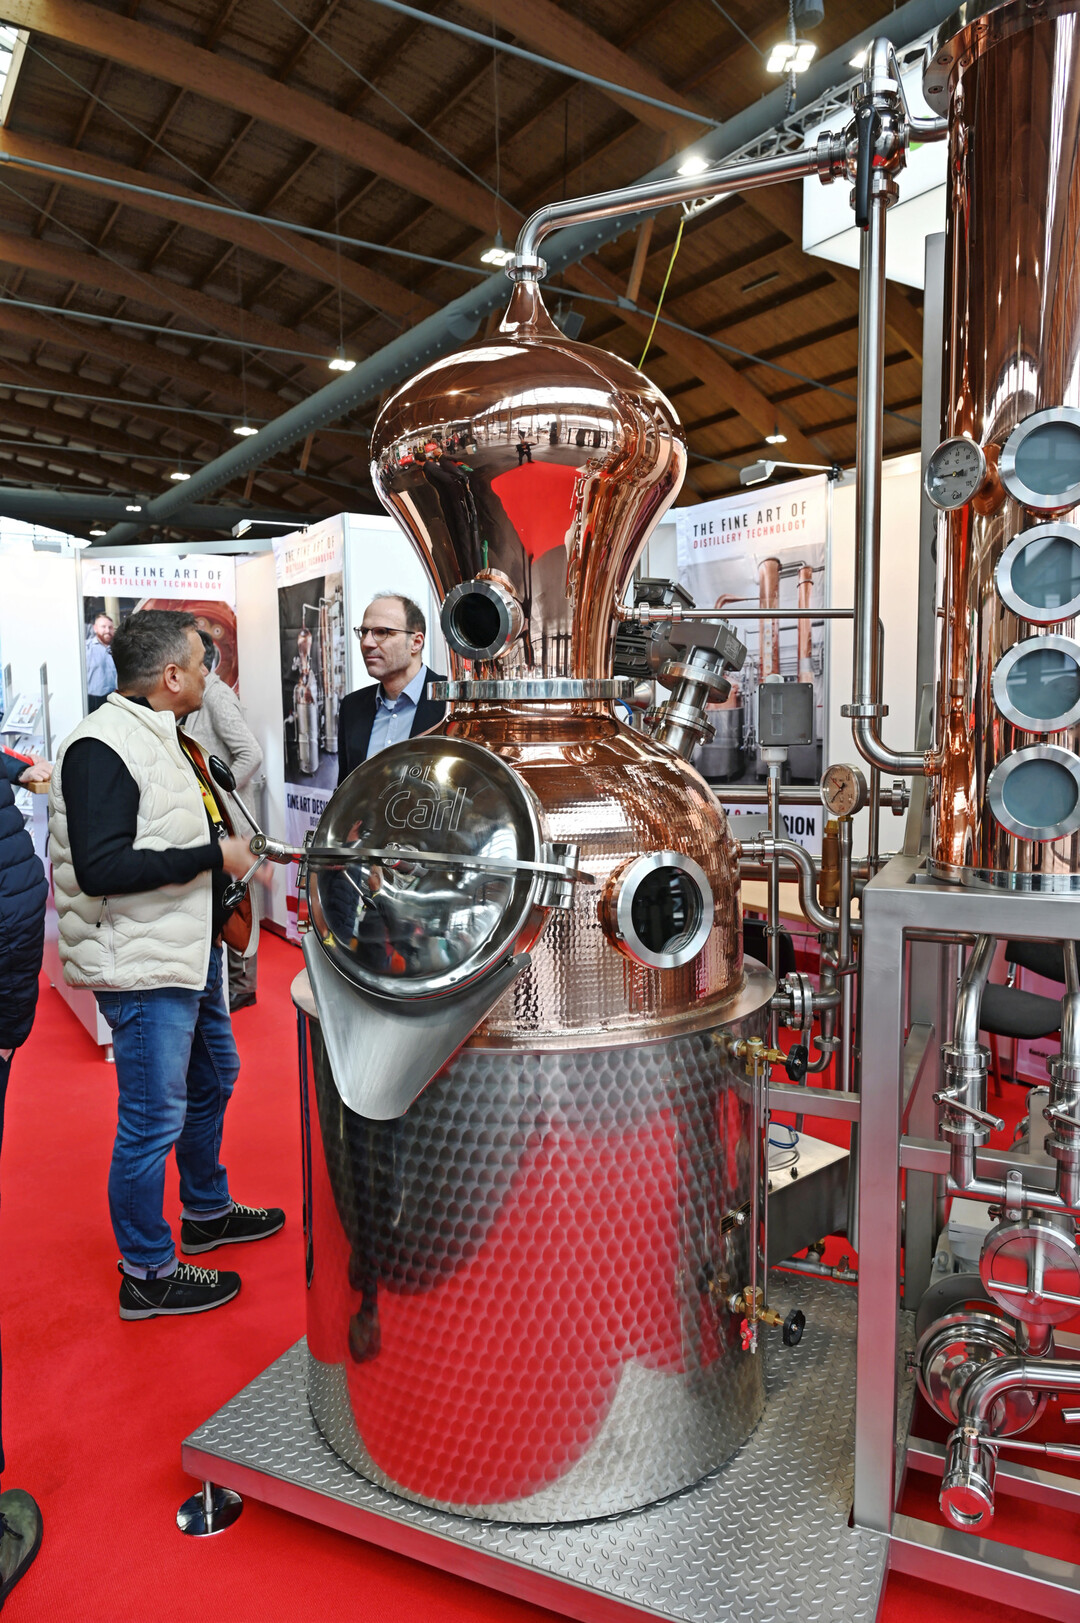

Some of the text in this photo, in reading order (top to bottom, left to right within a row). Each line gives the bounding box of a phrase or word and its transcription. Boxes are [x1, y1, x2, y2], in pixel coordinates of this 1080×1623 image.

[693, 501, 807, 538] THE FINE ART OF
[693, 519, 806, 550] DISTILLERY TECHNOLOGY
[285, 550, 295, 563] THE
[327, 535, 335, 549] OF
[100, 564, 222, 581] THE FINE ART OF
[101, 577, 222, 590] DISTILLERY TECHNOLOGY
[300, 795, 311, 813] ART
[384, 786, 467, 831] Carl
